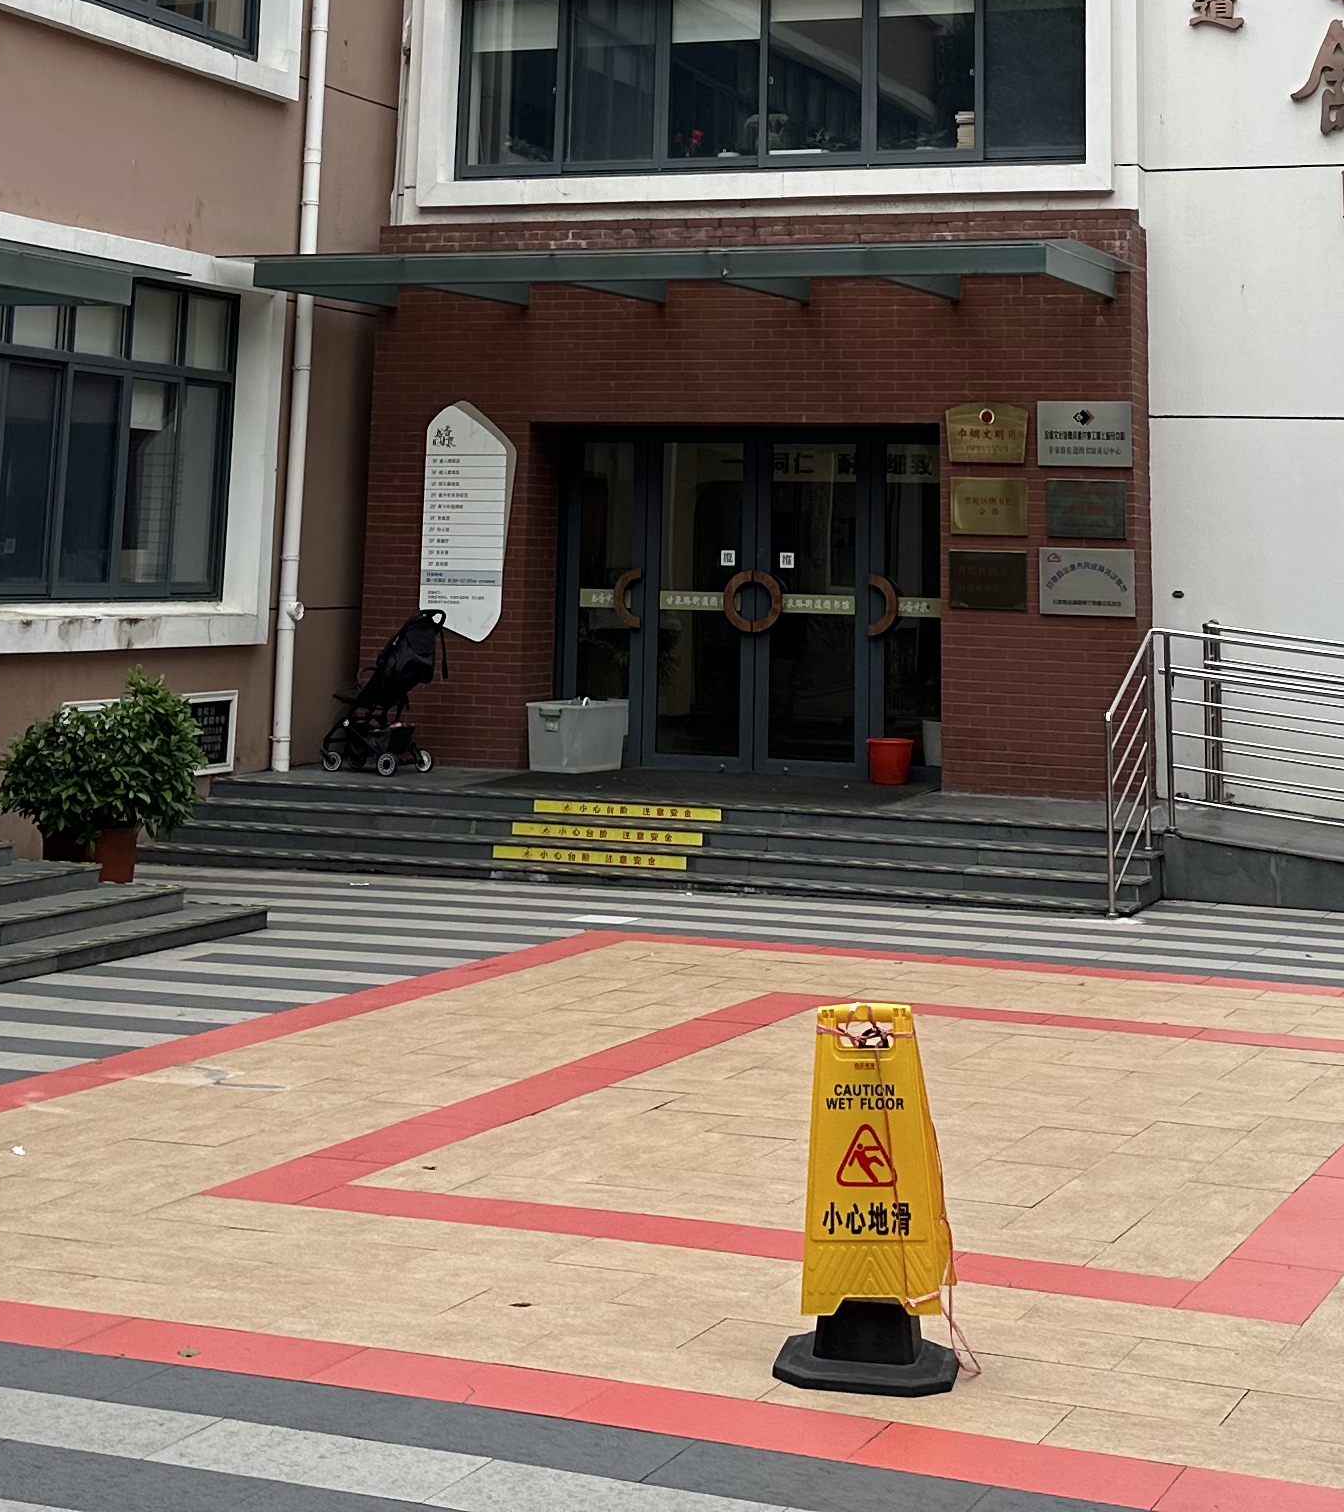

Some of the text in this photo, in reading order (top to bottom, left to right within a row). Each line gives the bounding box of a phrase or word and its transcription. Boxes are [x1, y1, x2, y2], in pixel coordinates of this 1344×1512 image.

[579, 804, 692, 818] 小心台阶 注意安全
[558, 827, 673, 842] 小心台阶 注意安全
[539, 850, 656, 865] 小心台阶 注意安全
[834, 1083, 895, 1097] CAUTION
[825, 1098, 905, 1110] WET FLOOR
[822, 1202, 911, 1237] 小心地滑
